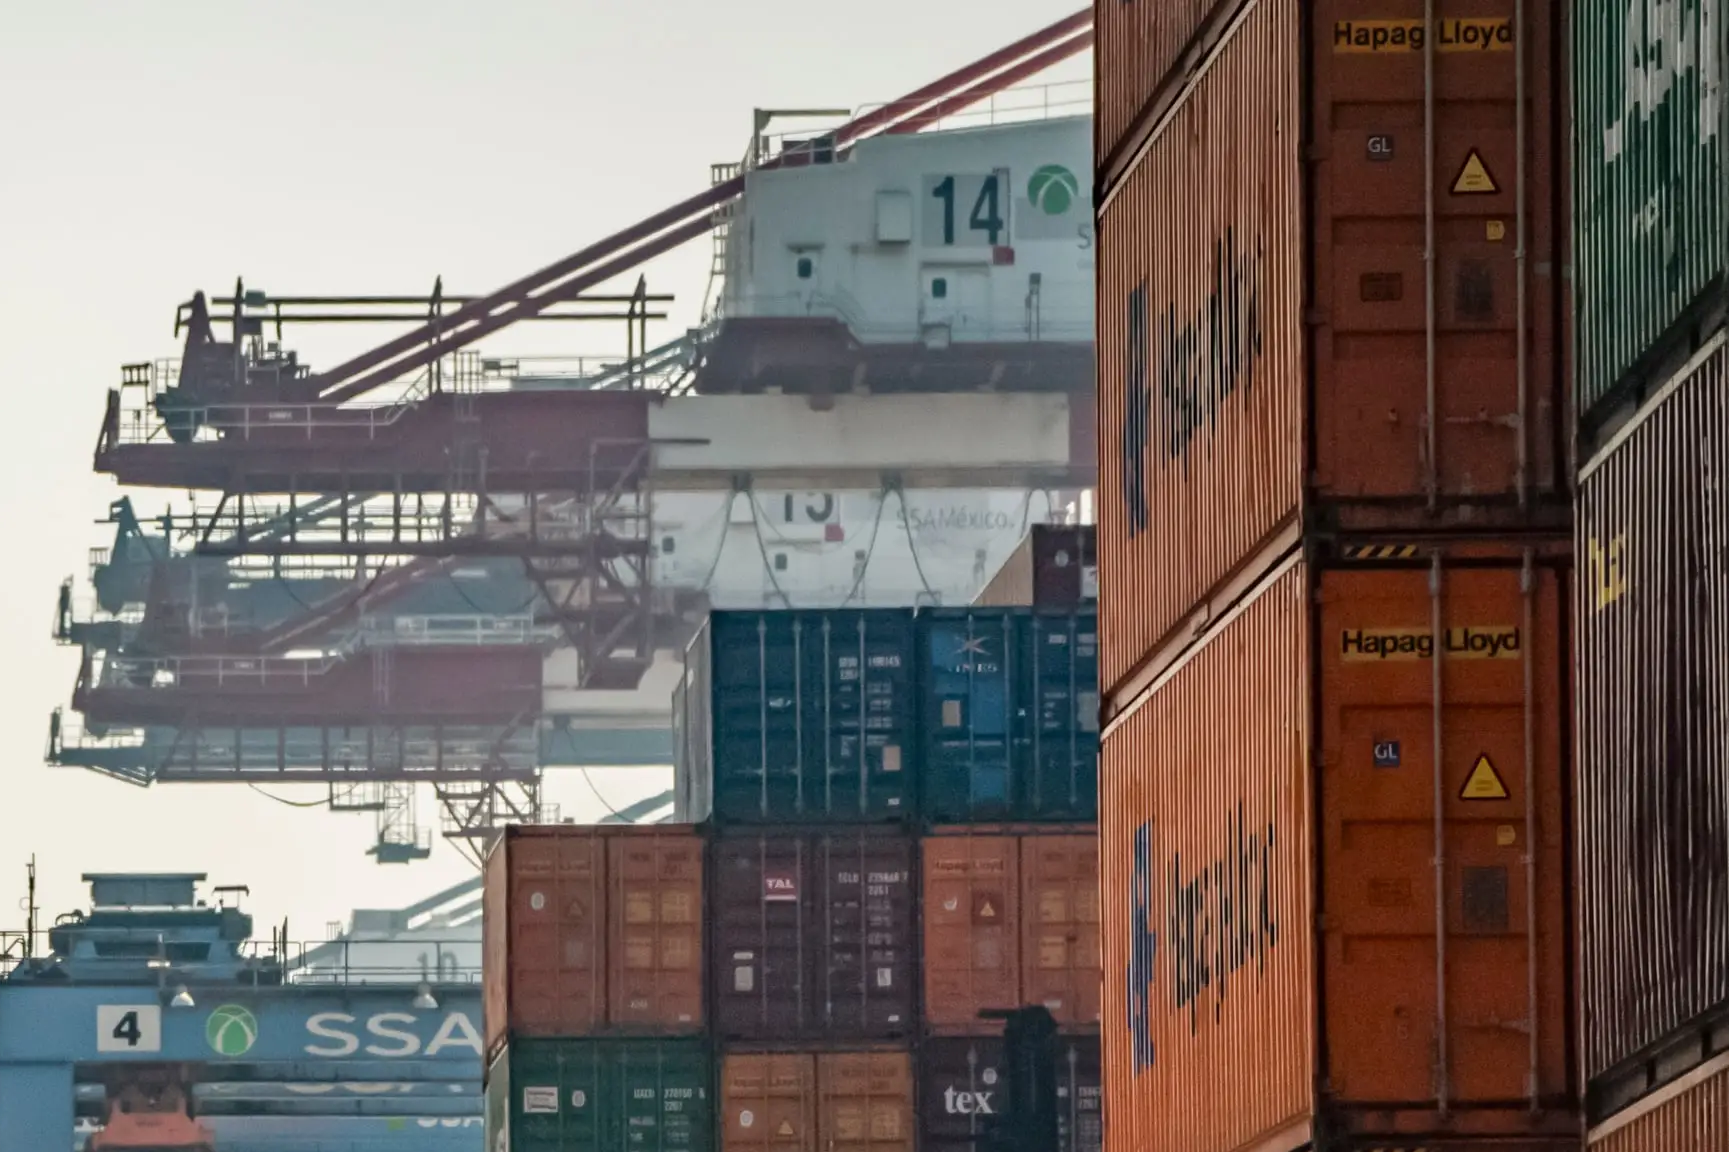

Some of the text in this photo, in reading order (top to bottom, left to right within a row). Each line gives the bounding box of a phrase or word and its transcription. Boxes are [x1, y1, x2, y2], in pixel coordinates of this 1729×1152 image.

[932, 175, 1003, 245] 14
[1342, 626, 1520, 658] Hapag Lloyd
[766, 878, 794, 889] TAL
[112, 1011, 141, 1046] 4
[943, 1083, 997, 1114] tex
